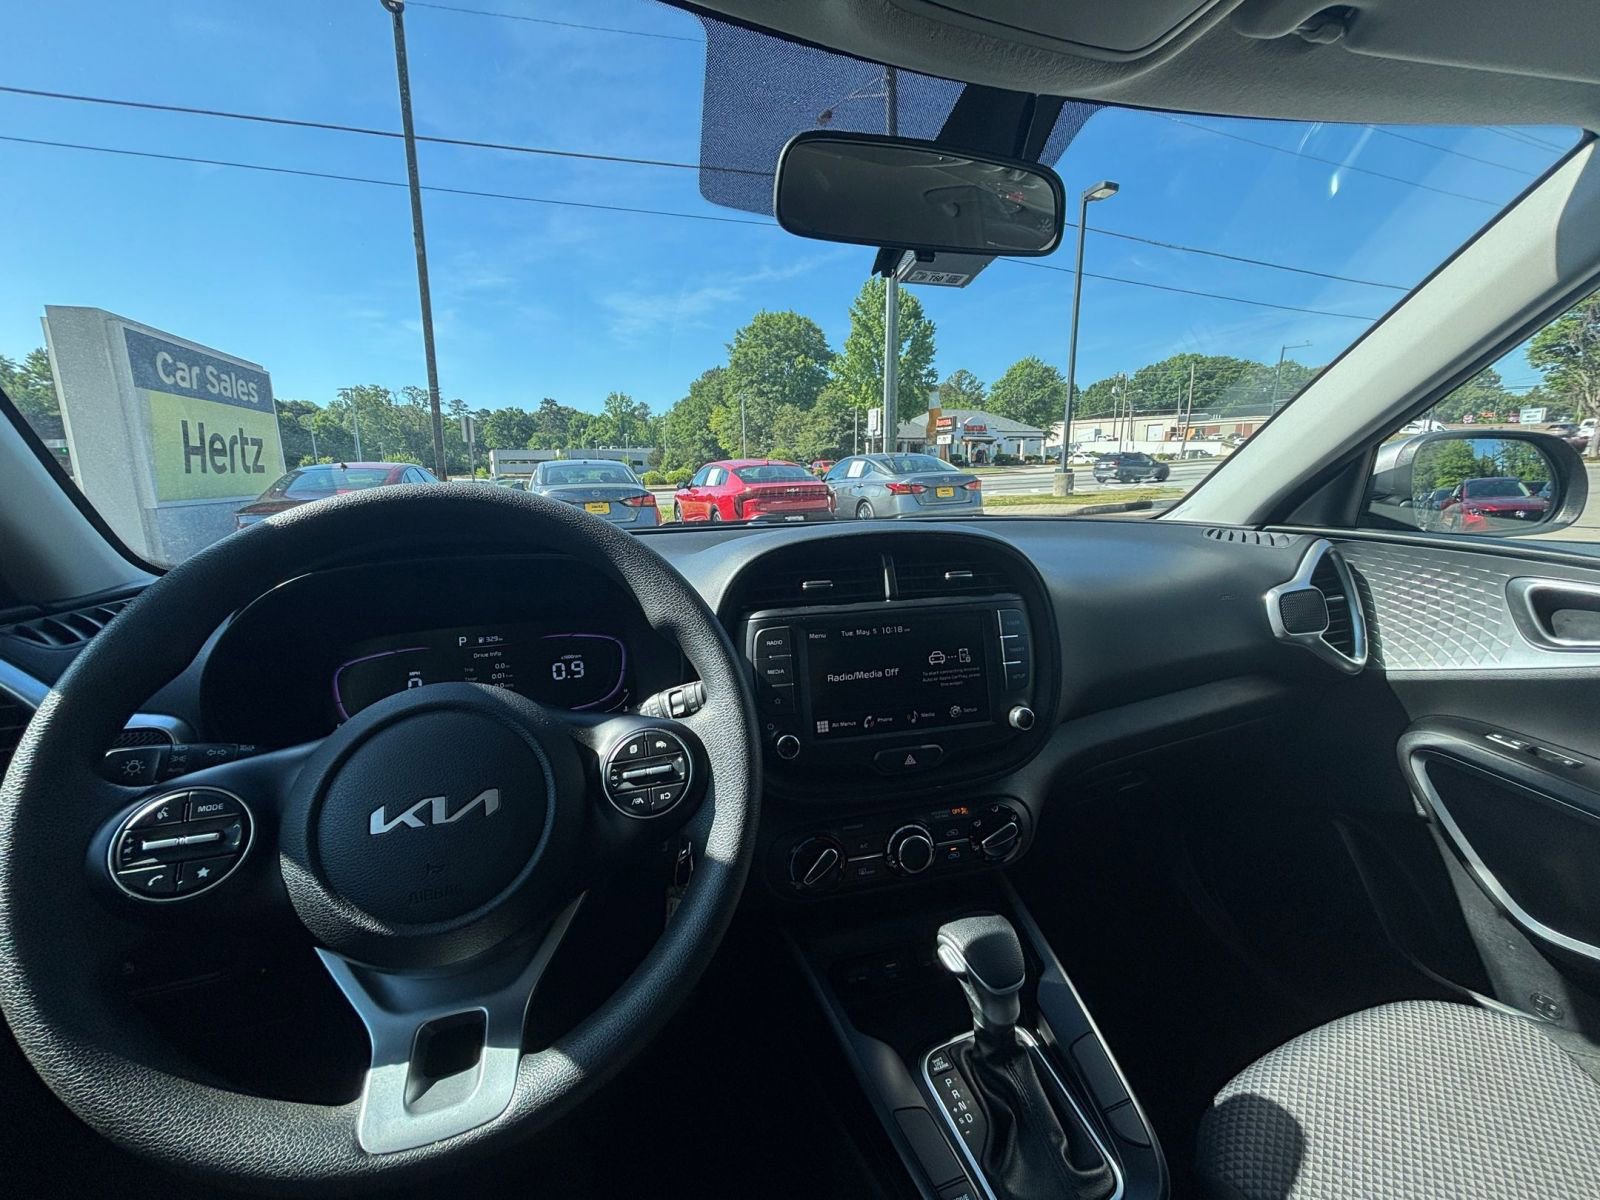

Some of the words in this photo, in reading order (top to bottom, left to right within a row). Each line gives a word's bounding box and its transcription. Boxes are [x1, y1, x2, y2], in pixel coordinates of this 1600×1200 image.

[156, 351, 200, 389] Car
[206, 365, 259, 403] Sales
[181, 420, 265, 474] Hertz
[882, 626, 903, 634] 10:18
[458, 636, 467, 647] P
[552, 660, 585, 680] 0.9
[827, 669, 883, 684] Radio/Media
[885, 668, 900, 678] Off
[197, 803, 224, 812] MODE
[368, 788, 502, 836] KIA
[945, 1078, 952, 1088] P
[952, 1089, 960, 1099] R
[958, 1101, 967, 1111] N
[965, 1113, 973, 1123] D
